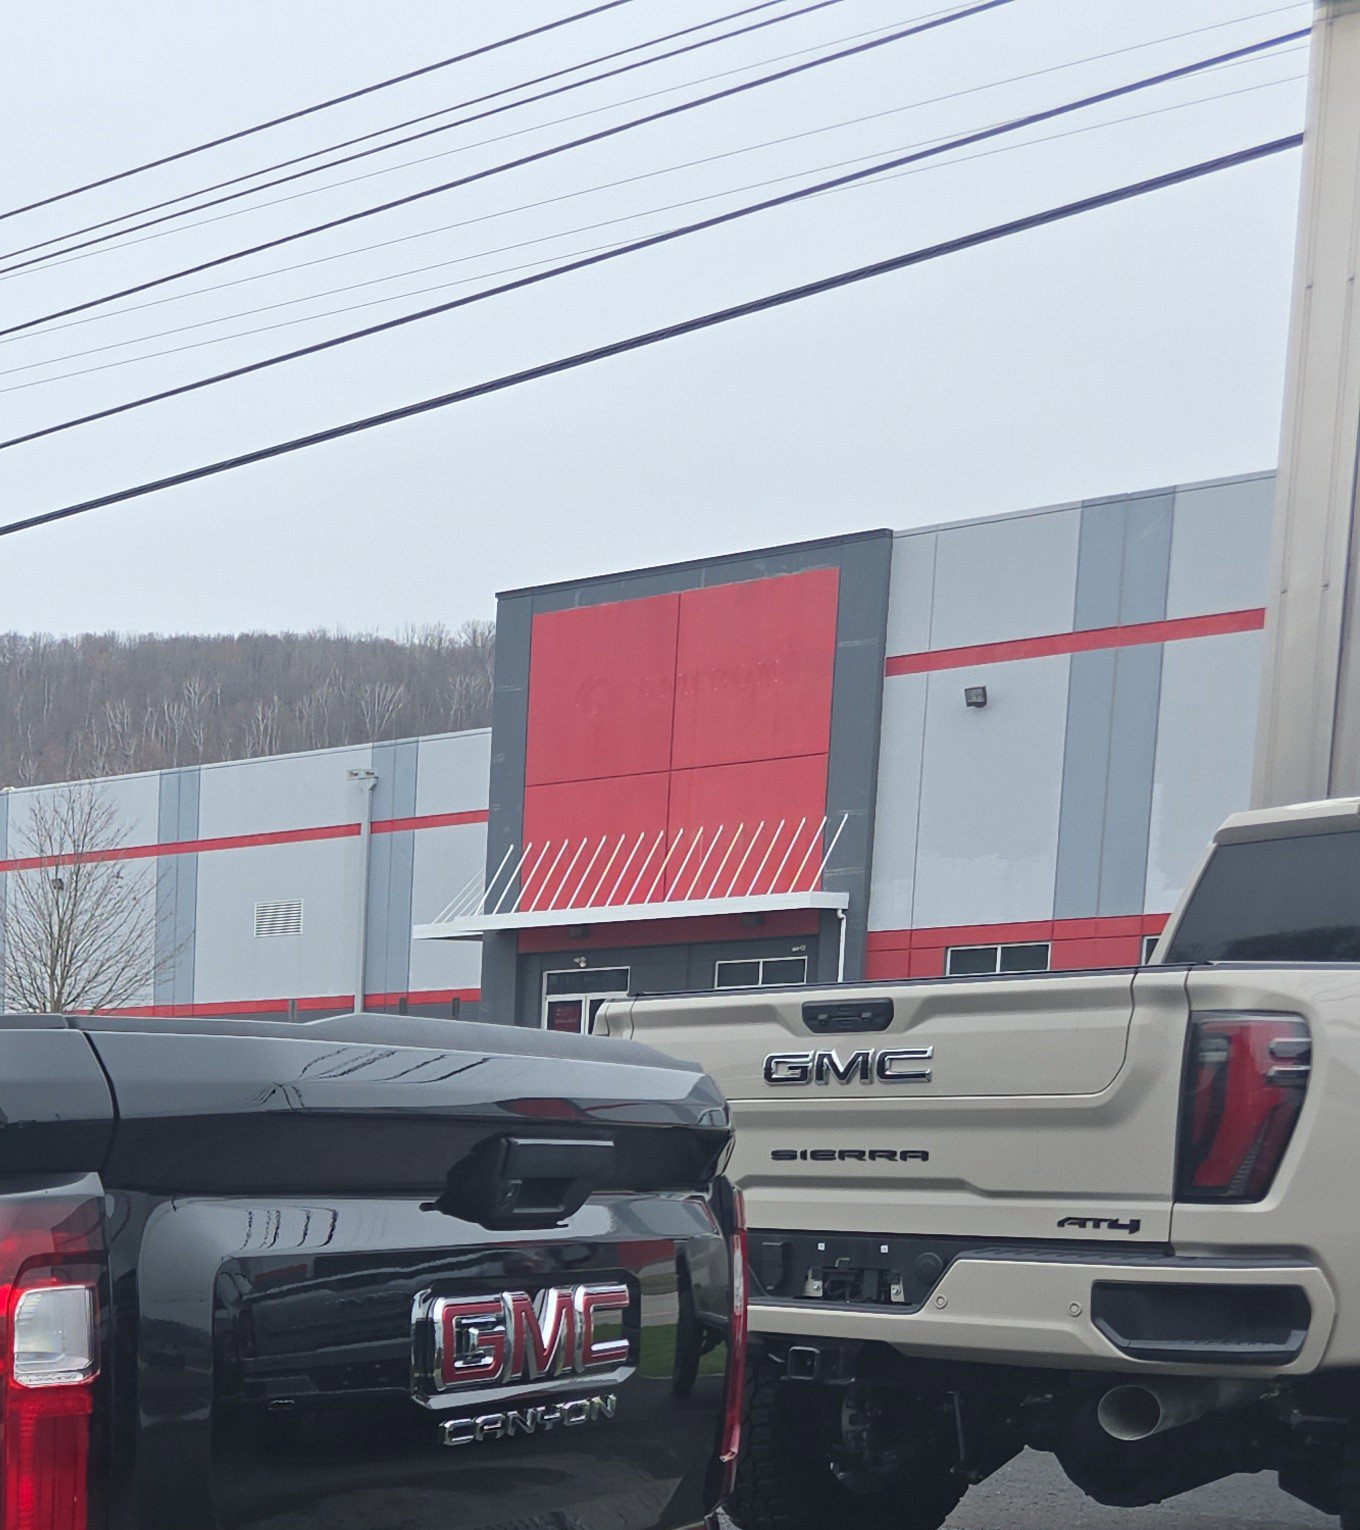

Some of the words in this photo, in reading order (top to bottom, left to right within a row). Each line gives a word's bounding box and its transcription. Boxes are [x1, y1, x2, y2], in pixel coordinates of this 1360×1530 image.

[763, 1045, 933, 1086] GMC
[770, 1149, 930, 1162] SIERRA
[1056, 1216, 1142, 1235] AT4
[432, 1283, 630, 1392] GMC
[438, 1393, 617, 1446] CANYON
